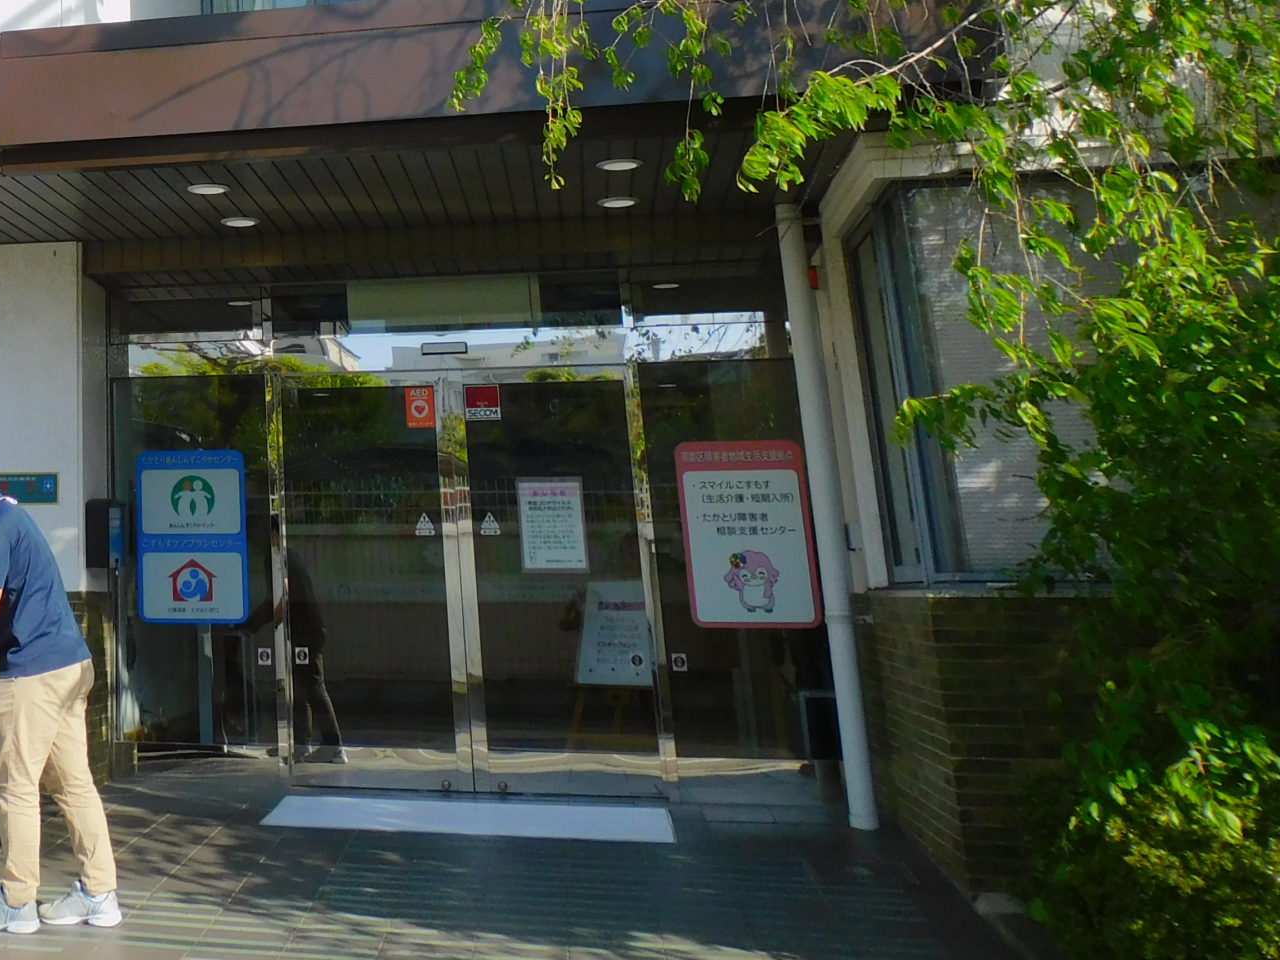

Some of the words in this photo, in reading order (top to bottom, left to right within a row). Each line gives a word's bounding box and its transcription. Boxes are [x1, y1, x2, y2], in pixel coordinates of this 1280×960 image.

[410, 388, 429, 397] AED
[468, 409, 498, 417] SECOM
[716, 525, 797, 536] 相談支援センター
